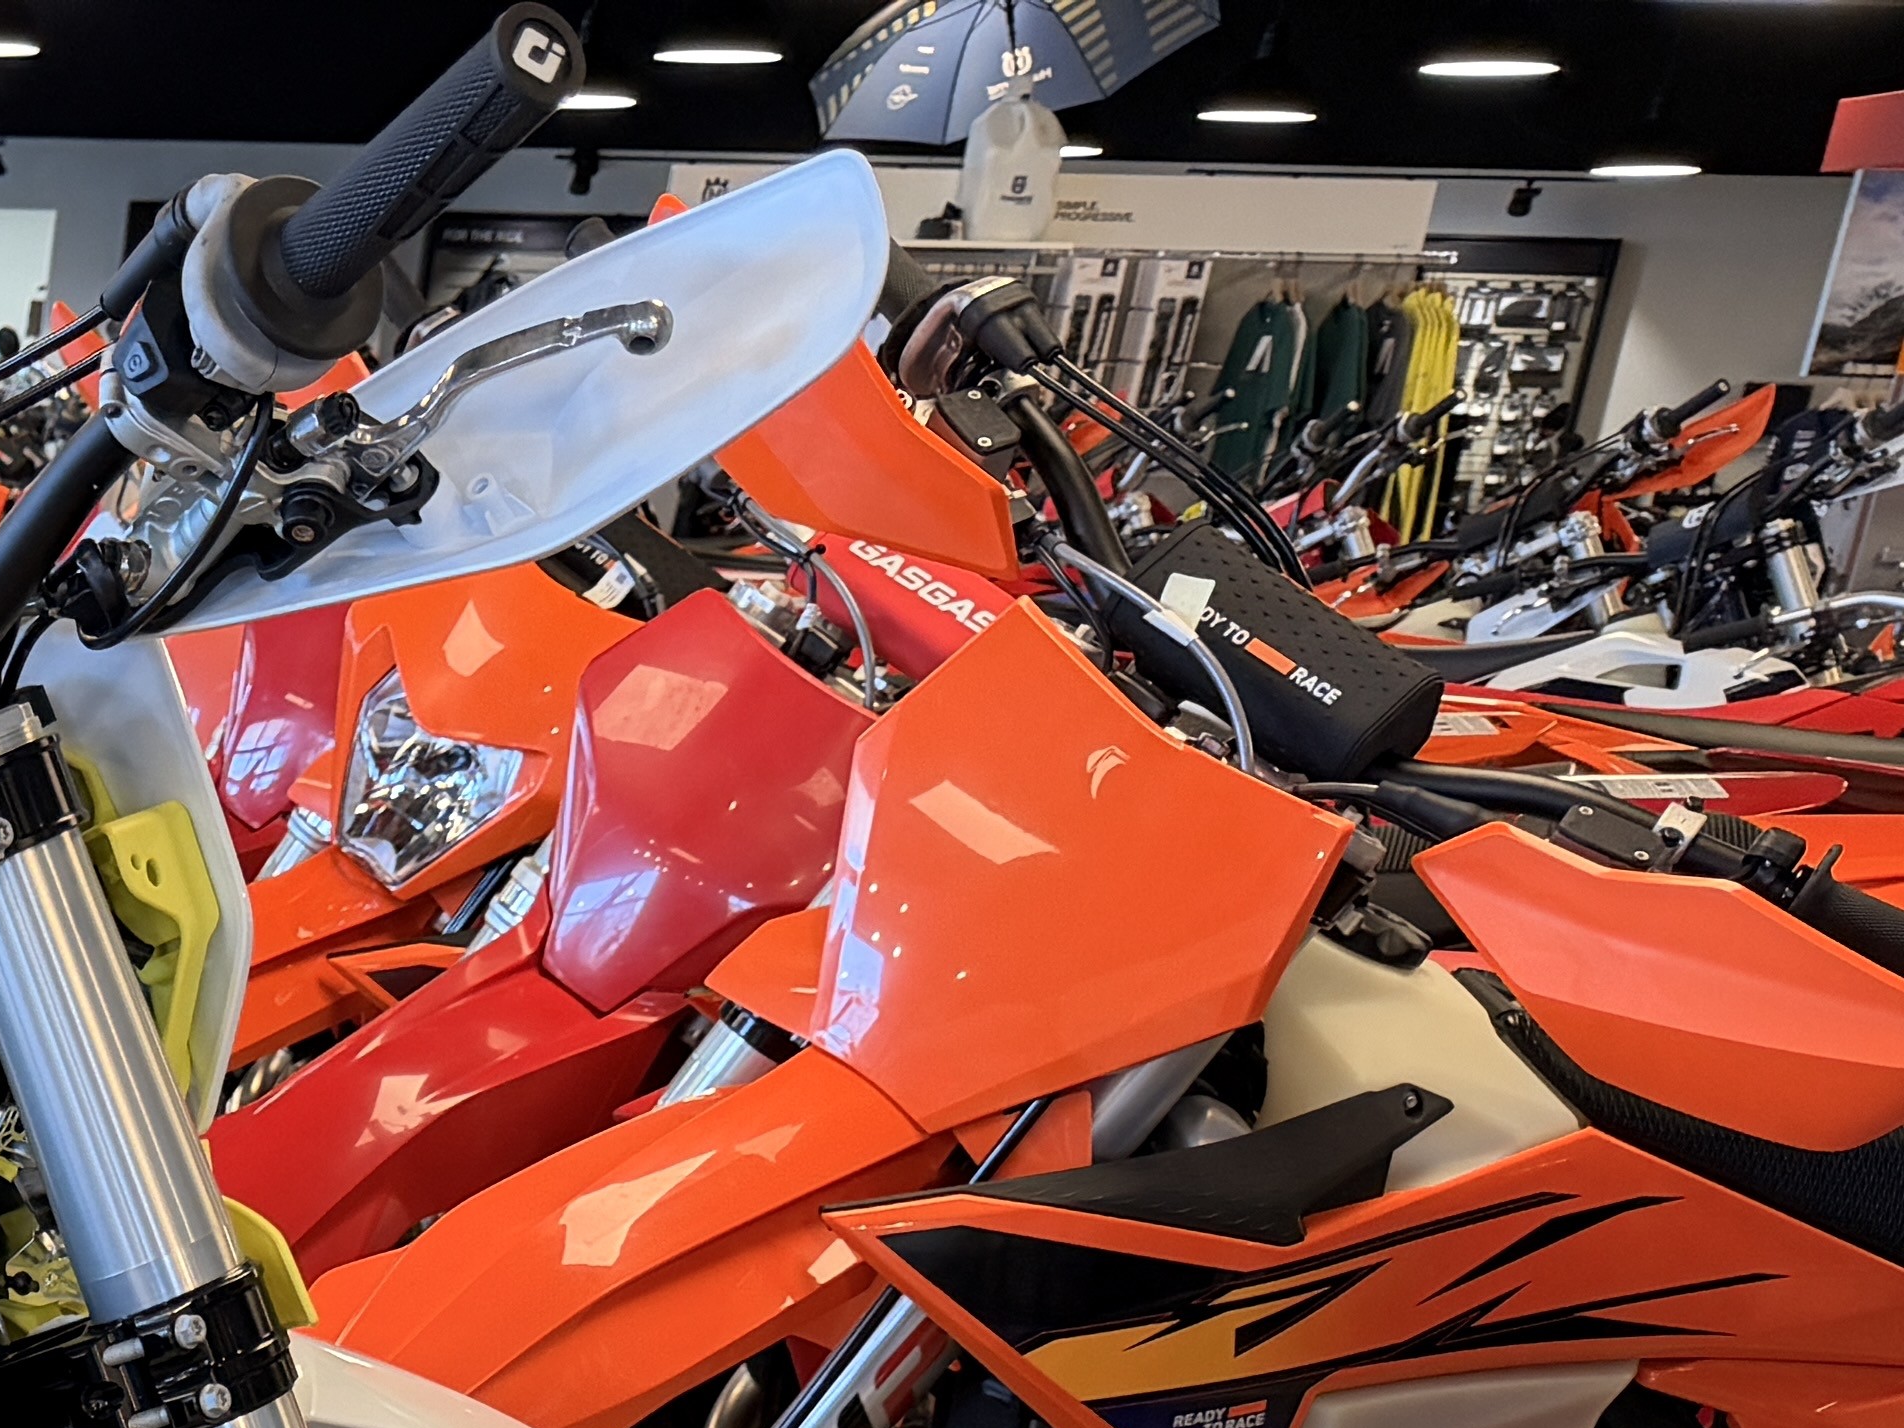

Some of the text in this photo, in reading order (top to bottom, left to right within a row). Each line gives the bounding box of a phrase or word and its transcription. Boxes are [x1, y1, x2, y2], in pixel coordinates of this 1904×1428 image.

[848, 540, 999, 634] GASGAS
[1222, 622, 1343, 706] TO RACE
[1173, 1407, 1227, 1428] READY
